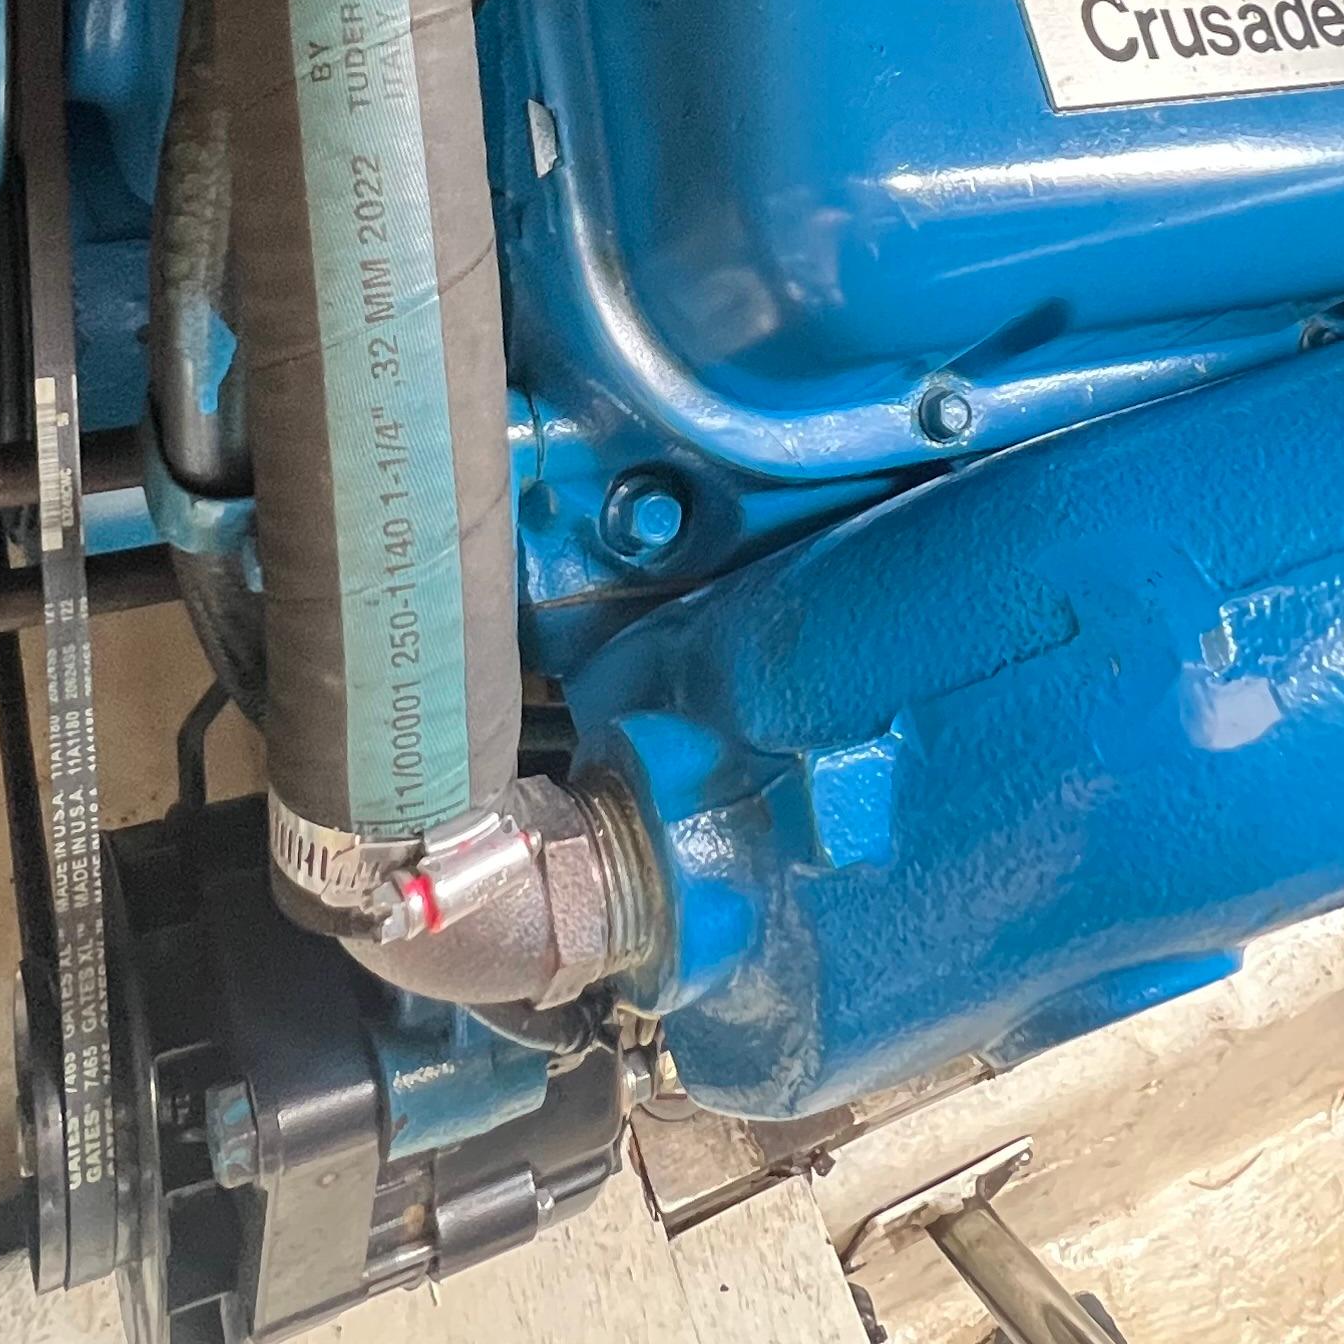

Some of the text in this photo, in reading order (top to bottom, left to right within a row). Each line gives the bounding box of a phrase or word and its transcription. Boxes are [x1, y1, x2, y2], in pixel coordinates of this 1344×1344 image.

[309, 40, 331, 82] BY
[341, 3, 371, 115] TUDER
[376, 10, 403, 99] ITAY
[352, 156, 388, 245] 2022
[360, 257, 396, 324] MM
[384, 517, 421, 668] 250-1140
[66, 711, 83, 776] 11A1180
[71, 837, 87, 855] IN
[72, 857, 89, 909] MADE
[78, 966, 97, 1033] GATES
[82, 1045, 101, 1092] 7465
